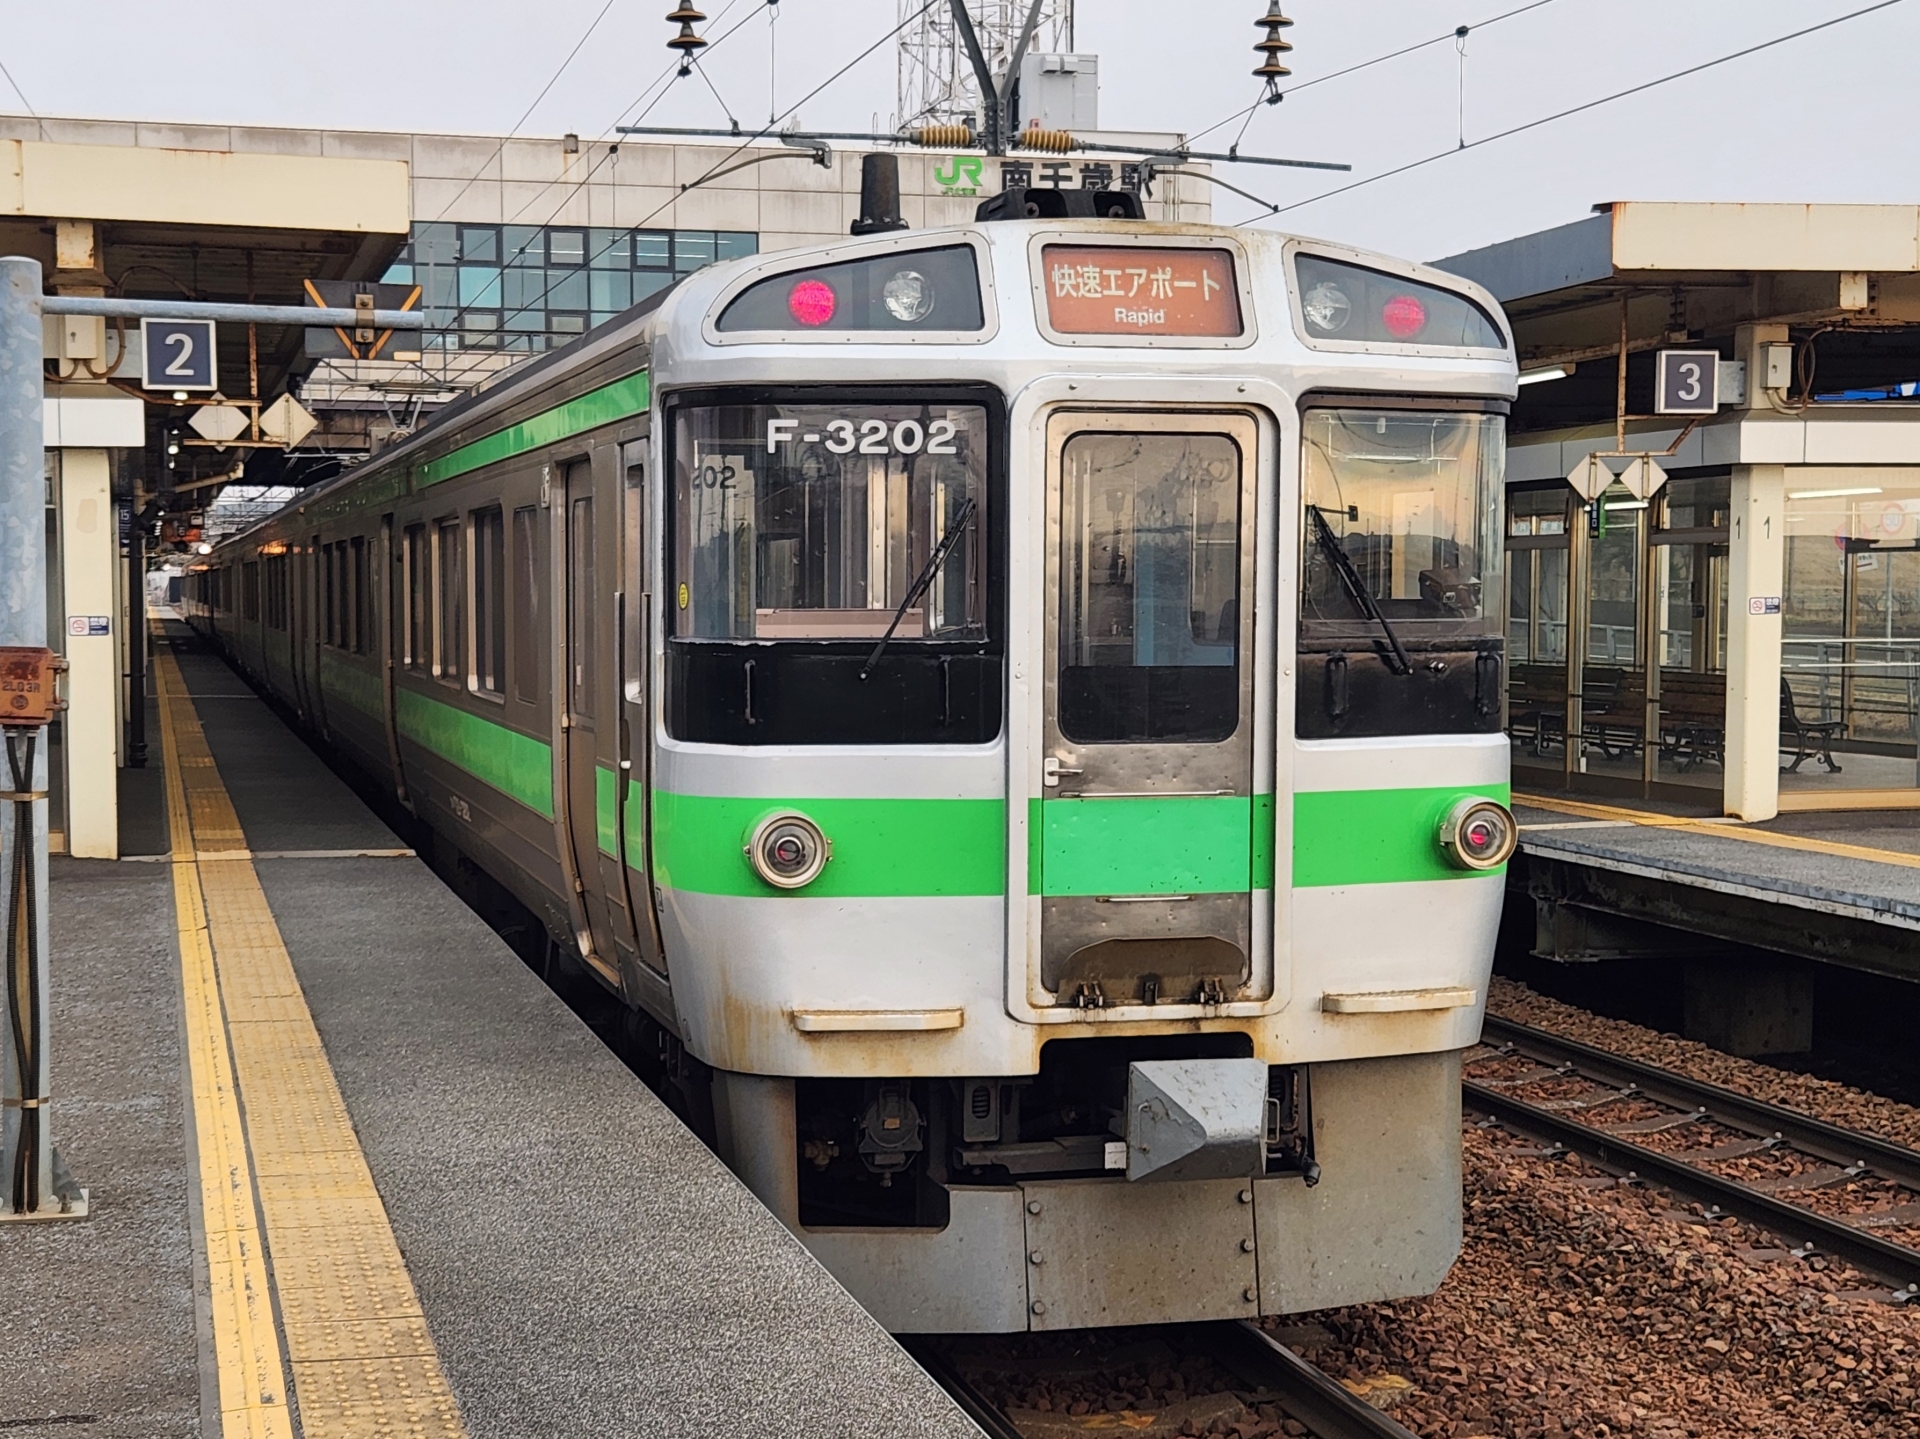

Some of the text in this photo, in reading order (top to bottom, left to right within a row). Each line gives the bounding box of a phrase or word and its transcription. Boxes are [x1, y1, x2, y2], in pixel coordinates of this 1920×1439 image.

[934, 155, 983, 187] JR
[1051, 263, 1221, 301] 快速エアポート
[1113, 307, 1166, 325] Rapid
[164, 333, 196, 376] 2
[1677, 362, 1702, 401] 3
[766, 418, 958, 455] F-3202
